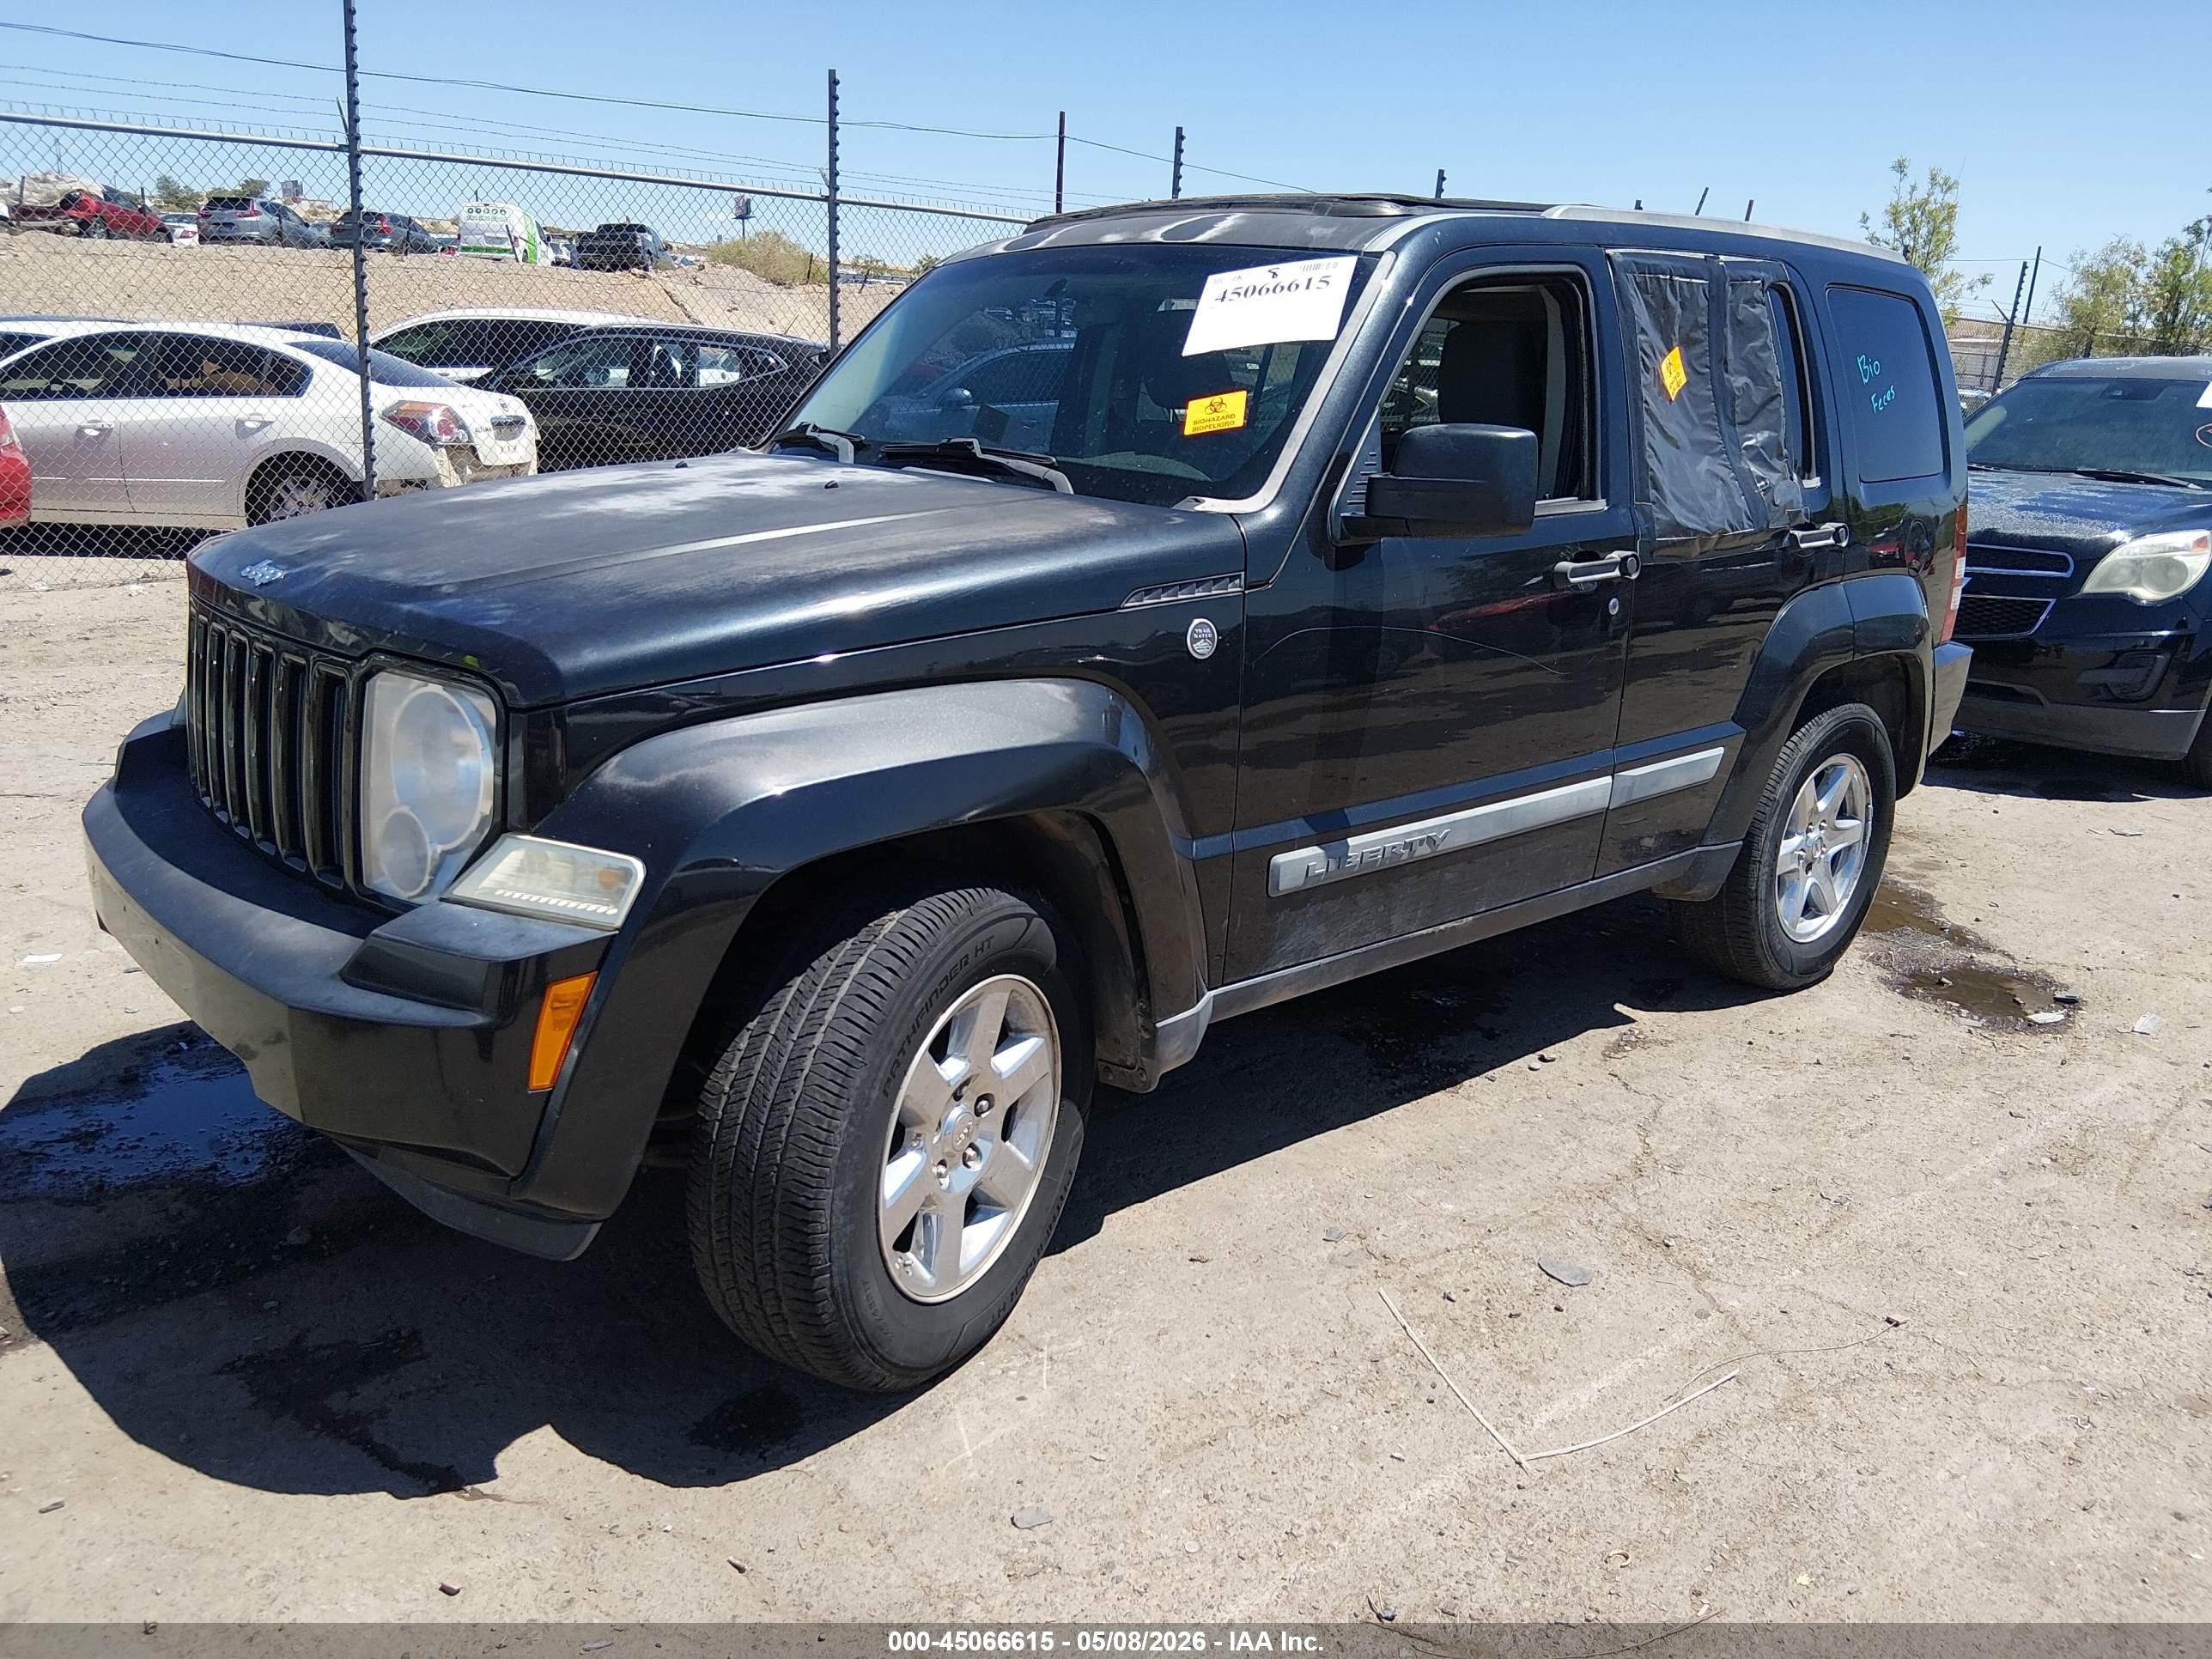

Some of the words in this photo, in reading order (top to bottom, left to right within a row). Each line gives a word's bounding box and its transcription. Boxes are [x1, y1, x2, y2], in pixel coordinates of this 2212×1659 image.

[1214, 275, 1333, 302] 45066615
[1856, 355, 1881, 385] Bio
[1871, 385, 1895, 413] Feces
[1192, 420, 1236, 433] BIOPELIGRO
[1193, 413, 1236, 426] BIOHAZARD
[1305, 829, 1451, 880] LIBERTY
[882, 953, 970, 1098] PATHFINDER
[973, 935, 995, 958] HT
